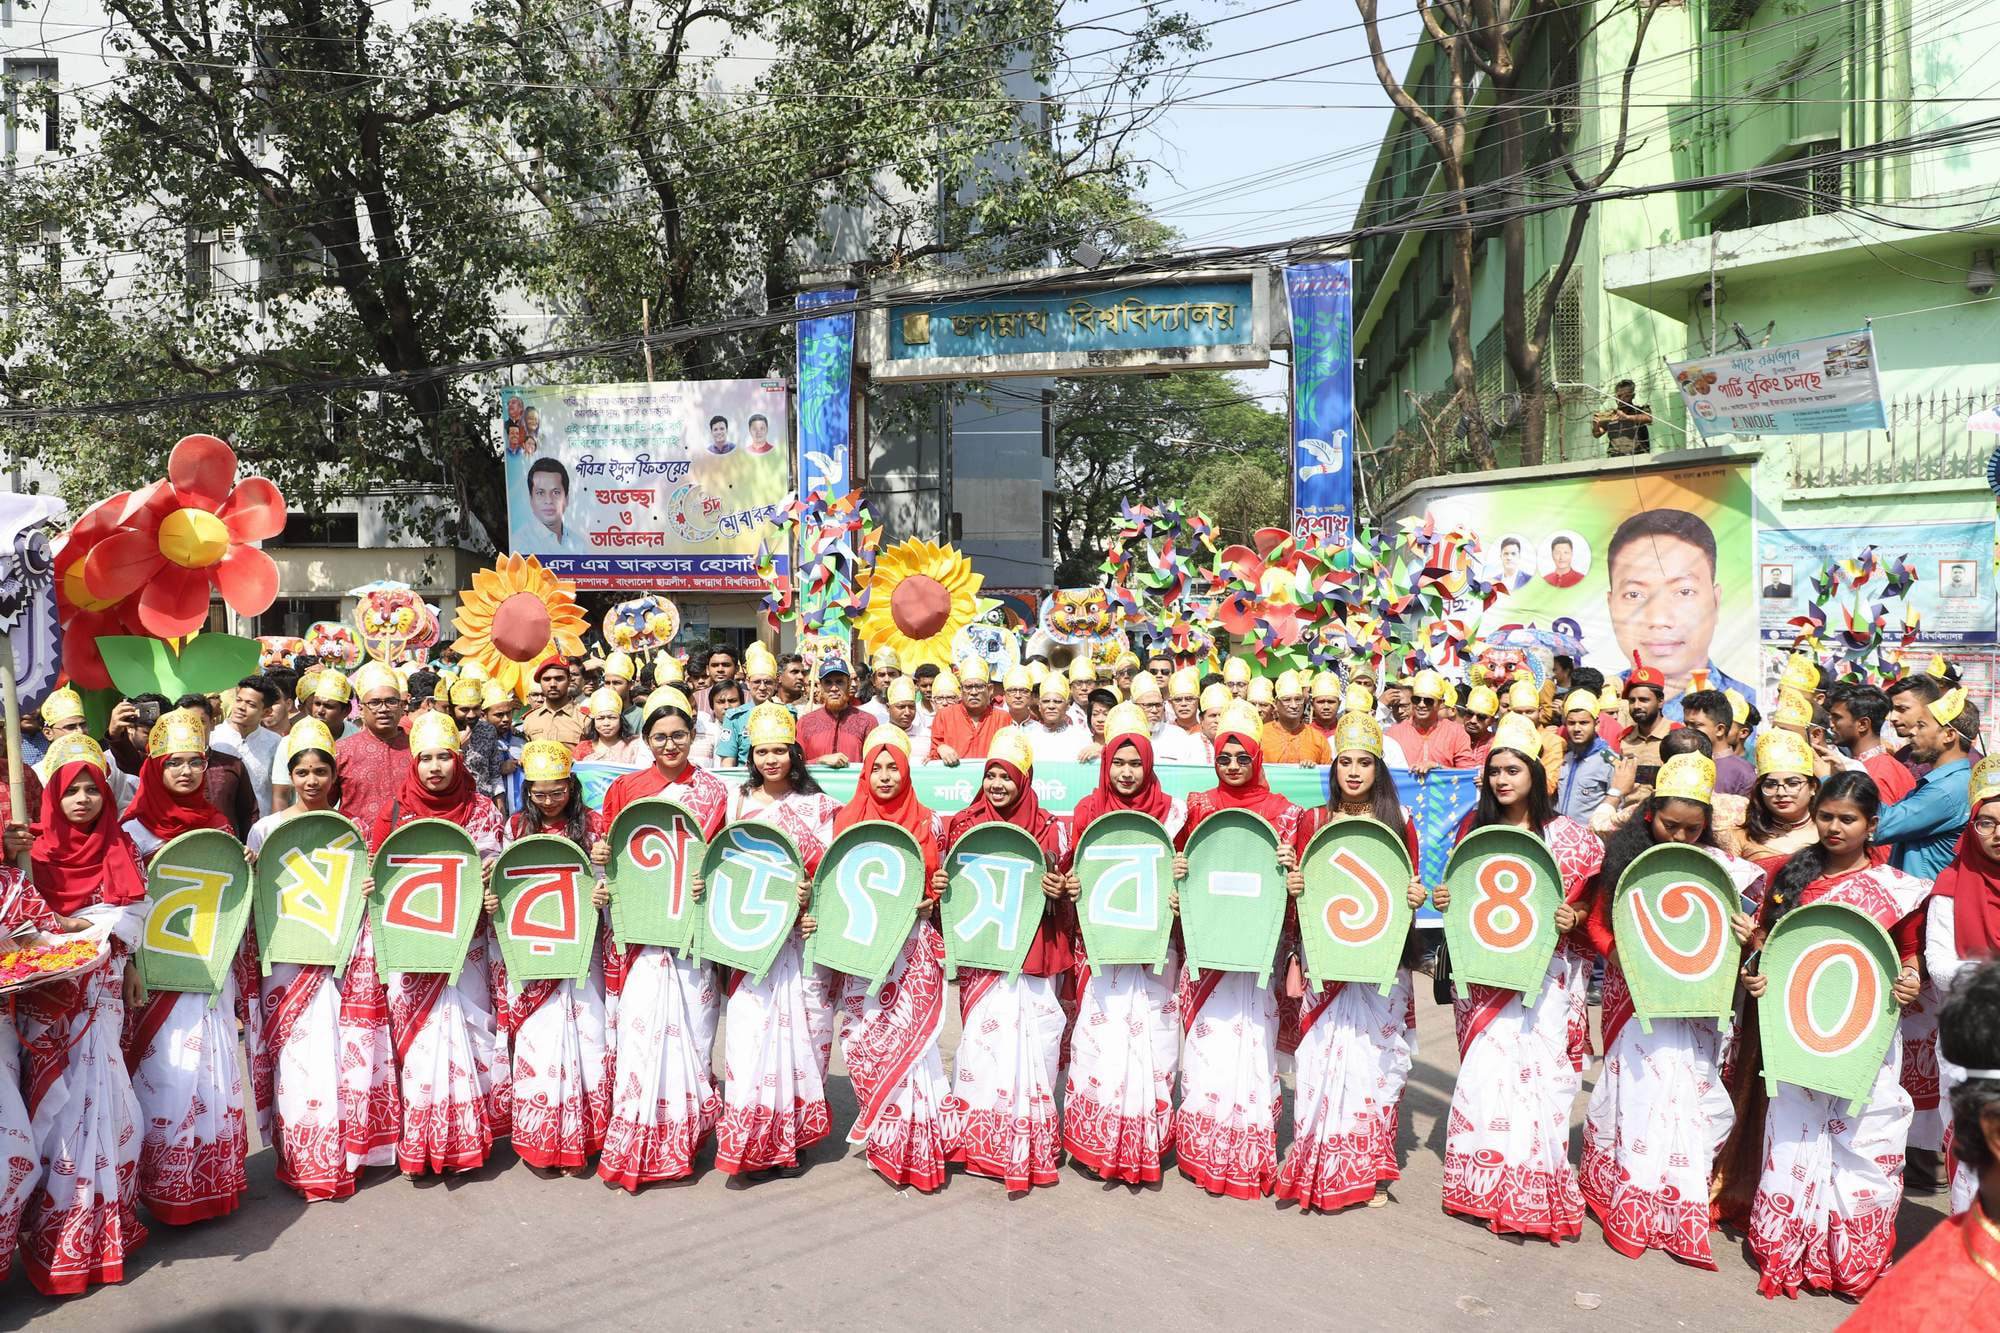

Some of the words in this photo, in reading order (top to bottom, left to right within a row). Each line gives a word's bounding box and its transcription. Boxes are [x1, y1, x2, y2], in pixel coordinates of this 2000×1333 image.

[949, 311, 1050, 343] জগন্নাথ
[1065, 298, 1238, 335] বিশ্ববিদ্যালয়
[1719, 376, 1743, 398] পার্টি
[1745, 374, 1783, 399] বুকিং
[1782, 372, 1822, 392] চলছে
[576, 455, 606, 478] পবিত্র
[636, 454, 691, 483] ফিতরের
[595, 489, 656, 509] শুভেচ্ছা
[620, 511, 633, 526] ও
[590, 526, 665, 547] অভিনন্দন
[545, 558, 575, 572] এস
[581, 558, 610, 572] এম
[617, 558, 693, 573] আকতার
[700, 556, 779, 573] হোসাই
